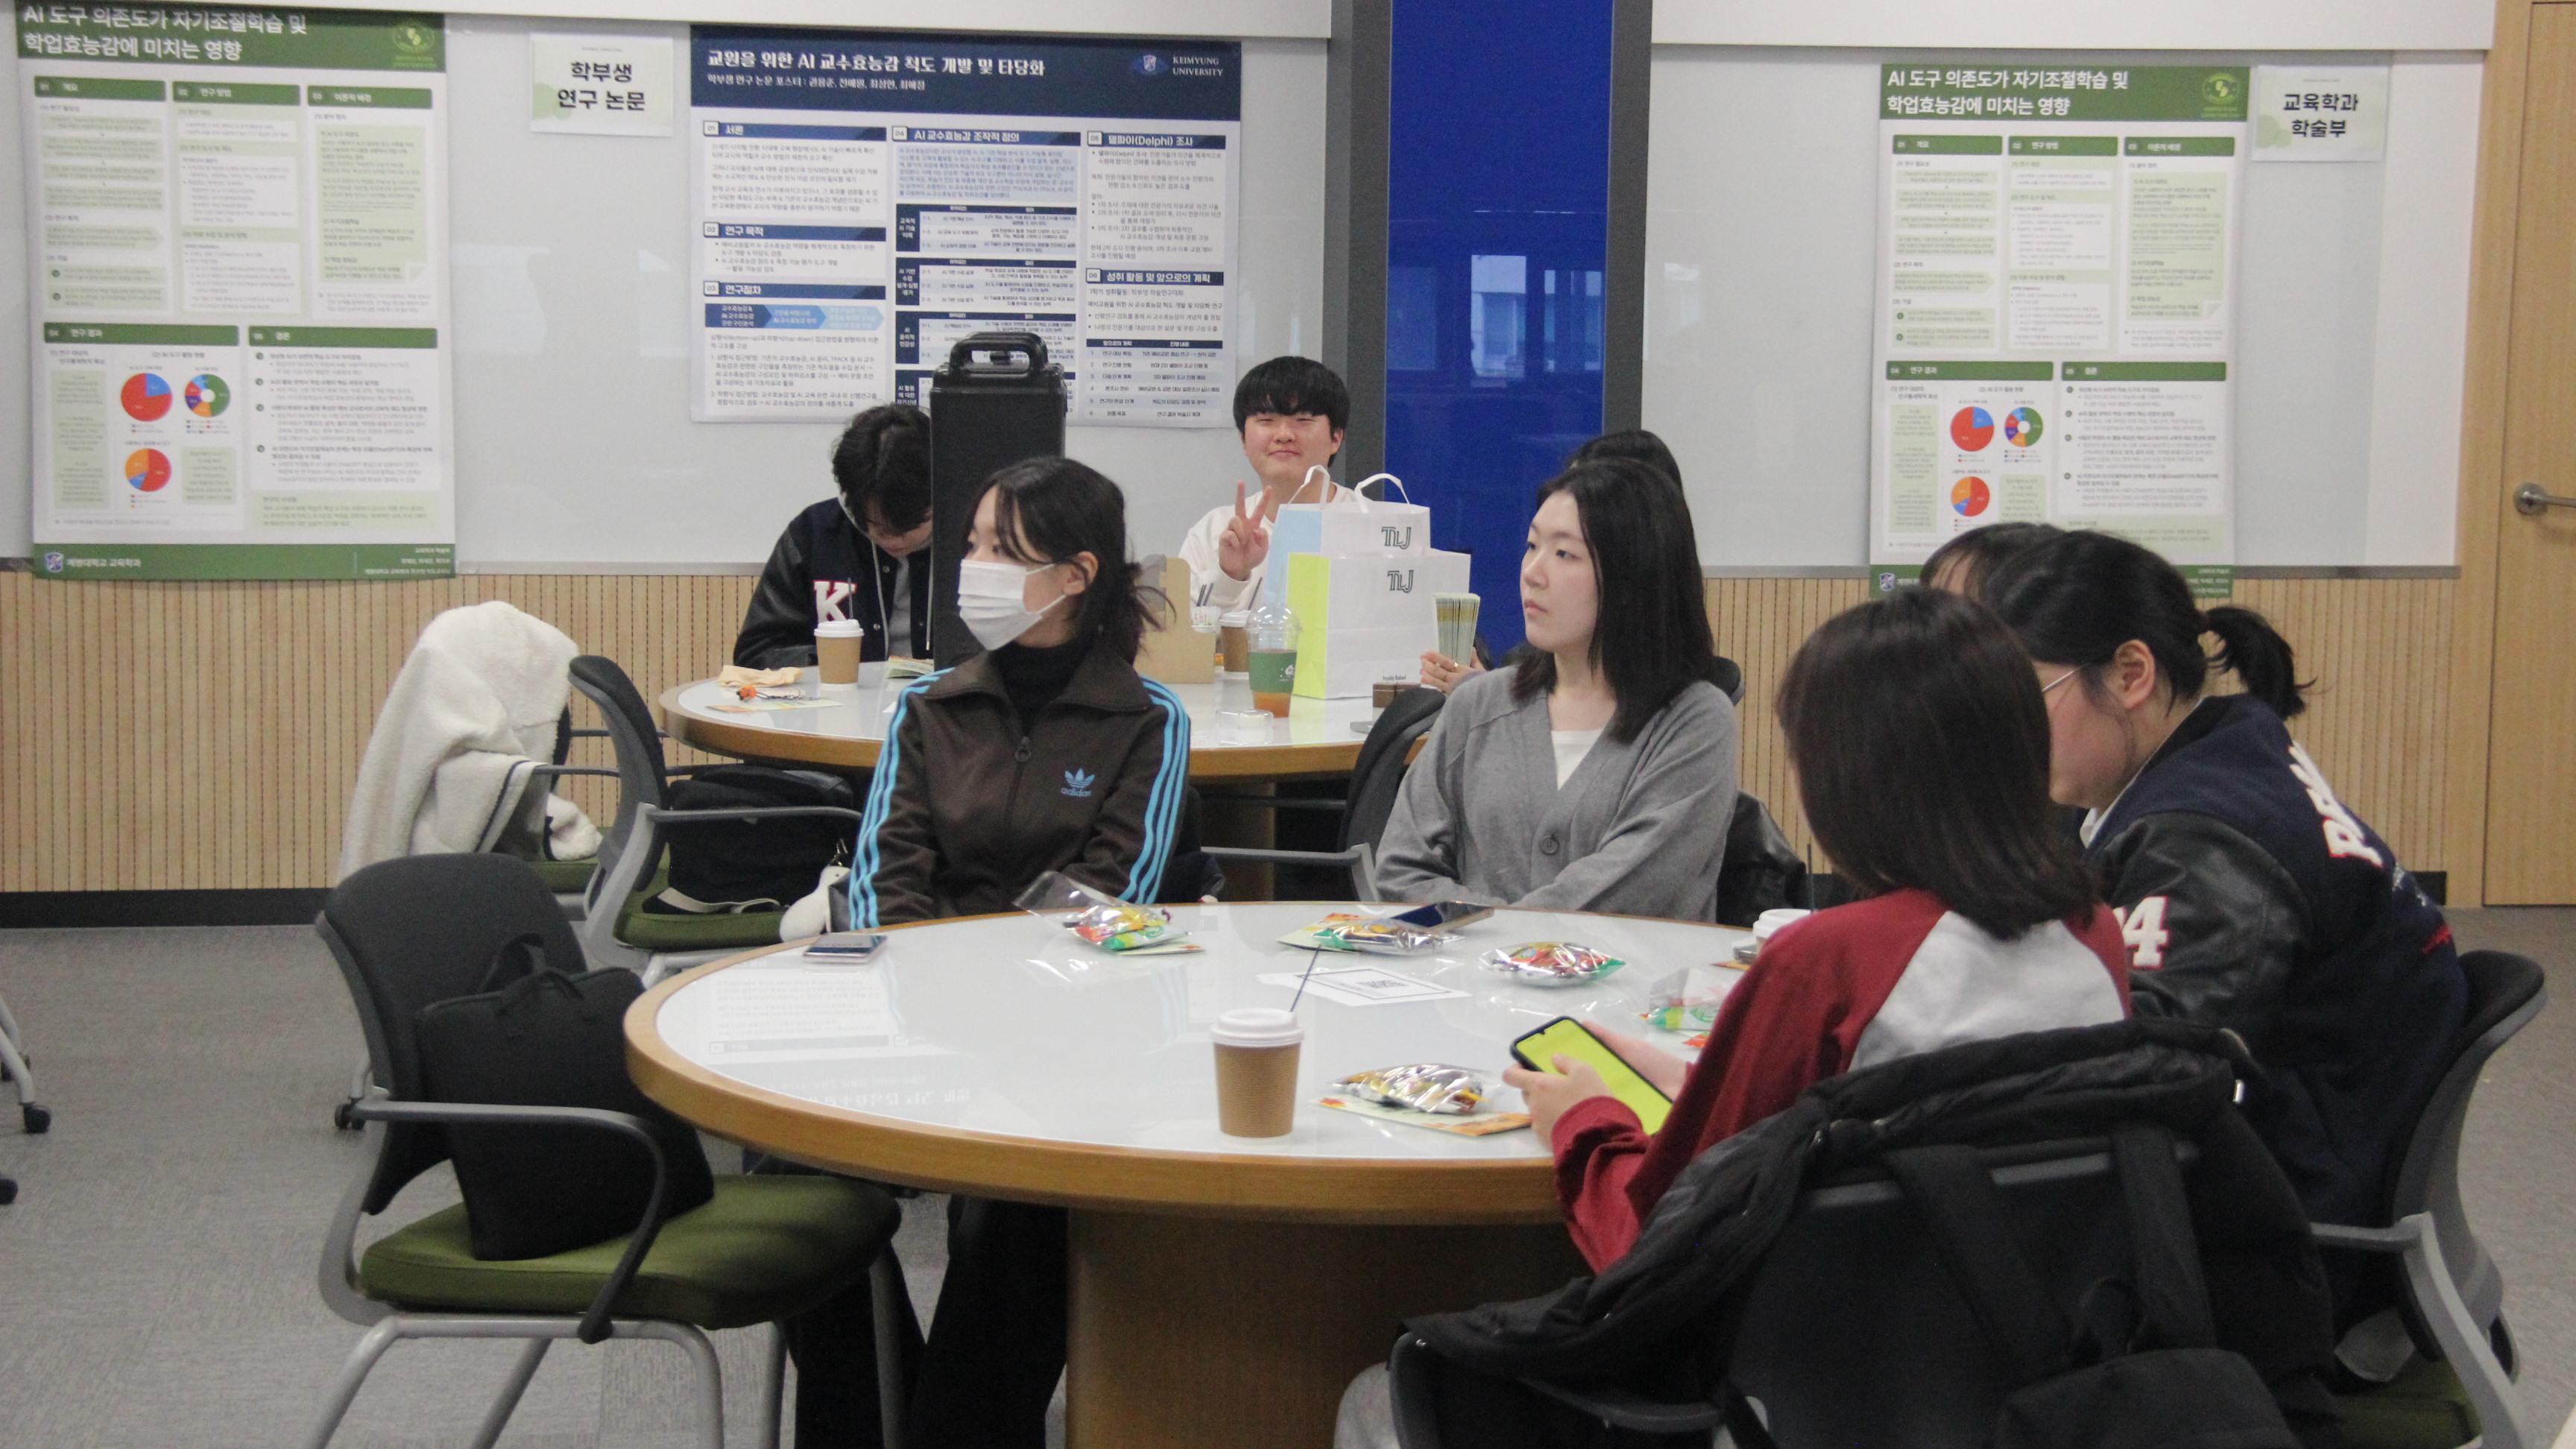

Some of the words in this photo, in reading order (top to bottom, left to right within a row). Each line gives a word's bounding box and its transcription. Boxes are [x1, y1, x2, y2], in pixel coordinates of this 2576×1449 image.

[24, 6, 44, 24] AI
[49, 7, 88, 25] 도구
[93, 8, 167, 28] 의존도가
[172, 10, 285, 31] 자기조절학습
[290, 14, 307, 32] 및
[25, 34, 139, 56] 학업효능감에
[145, 37, 200, 57] 미치는
[204, 39, 242, 59] 영향
[708, 50, 756, 69] 교원을
[761, 51, 793, 71] 위한
[798, 53, 815, 71] AI
[820, 54, 898, 74] 교수효능감
[904, 56, 936, 75] 척도
[942, 57, 973, 76] 개발
[977, 58, 993, 77] 및
[998, 59, 1044, 78] 타당화
[1172, 57, 1219, 65] KEIMYUNG
[570, 62, 632, 82] 학부생
[1172, 67, 1223, 76] UNIVERSITY
[1887, 70, 1904, 86] AI
[1908, 70, 1939, 86] 도구
[1945, 71, 2008, 87] 의존도가
[2012, 71, 2108, 88] 자기조절학습
[2112, 72, 2129, 88] 및
[558, 89, 598, 110] 연구
[605, 89, 645, 110] 논문
[1887, 96, 1982, 114] 학업효능감에
[1986, 97, 2034, 114] 미치는
[2038, 97, 2070, 115] 영향
[2283, 93, 2358, 111] 교육학과
[914, 132, 926, 140] AI
[2291, 120, 2346, 137] 학술부
[1176, 136, 1193, 145] 조사
[1381, 526, 1411, 549] TLJ
[1387, 569, 1413, 593] TLJ
[813, 579, 857, 622] K
[1061, 788, 1092, 797] adidas
